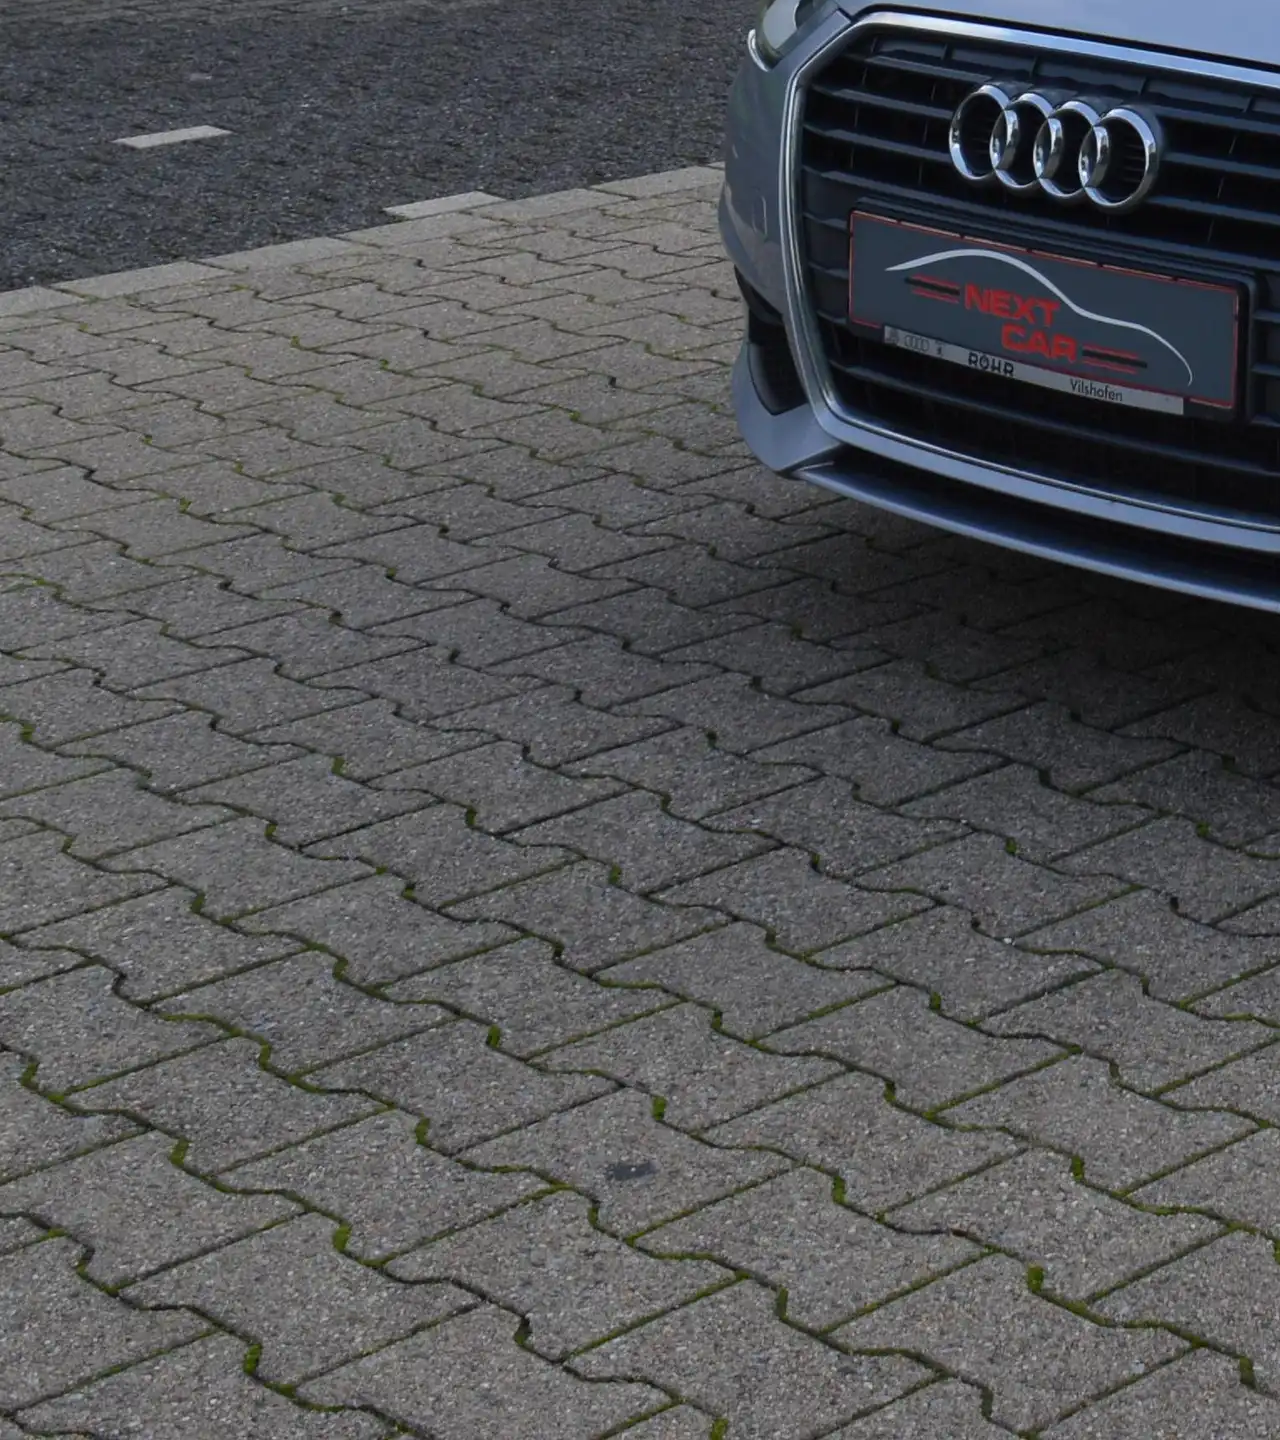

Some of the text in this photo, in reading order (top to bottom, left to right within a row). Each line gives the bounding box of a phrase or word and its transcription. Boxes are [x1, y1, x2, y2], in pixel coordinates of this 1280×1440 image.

[964, 281, 1061, 328] NEXT
[1001, 322, 1078, 364] CAR
[1070, 378, 1123, 402] Vilshofen
